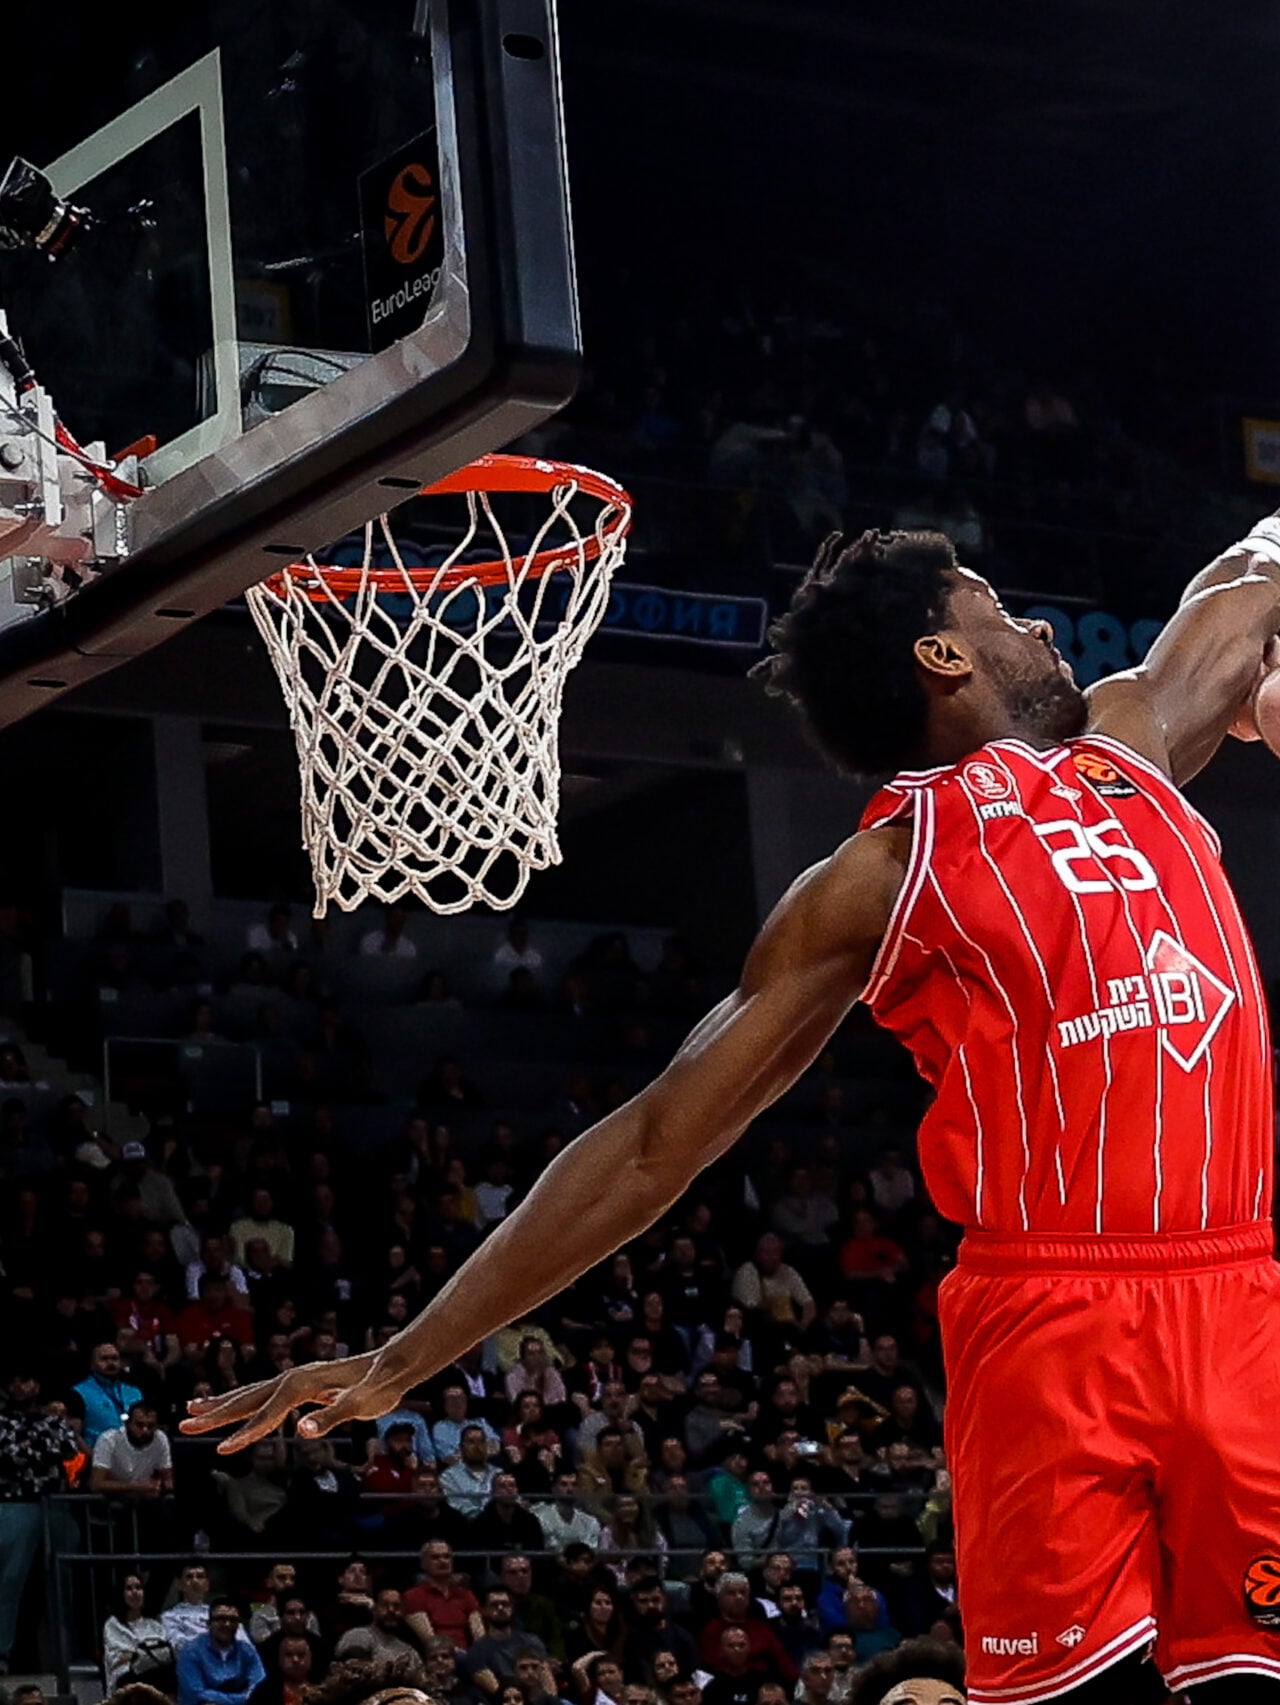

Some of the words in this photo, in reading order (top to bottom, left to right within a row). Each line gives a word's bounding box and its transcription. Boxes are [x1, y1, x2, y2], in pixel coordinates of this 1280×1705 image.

[1033, 818, 1159, 894] 25
[1106, 975, 1150, 1005] בית
[1151, 970, 1206, 1025] IBI
[1057, 1001, 1153, 1048] השקעות
[982, 1631, 1038, 1655] nuvei
